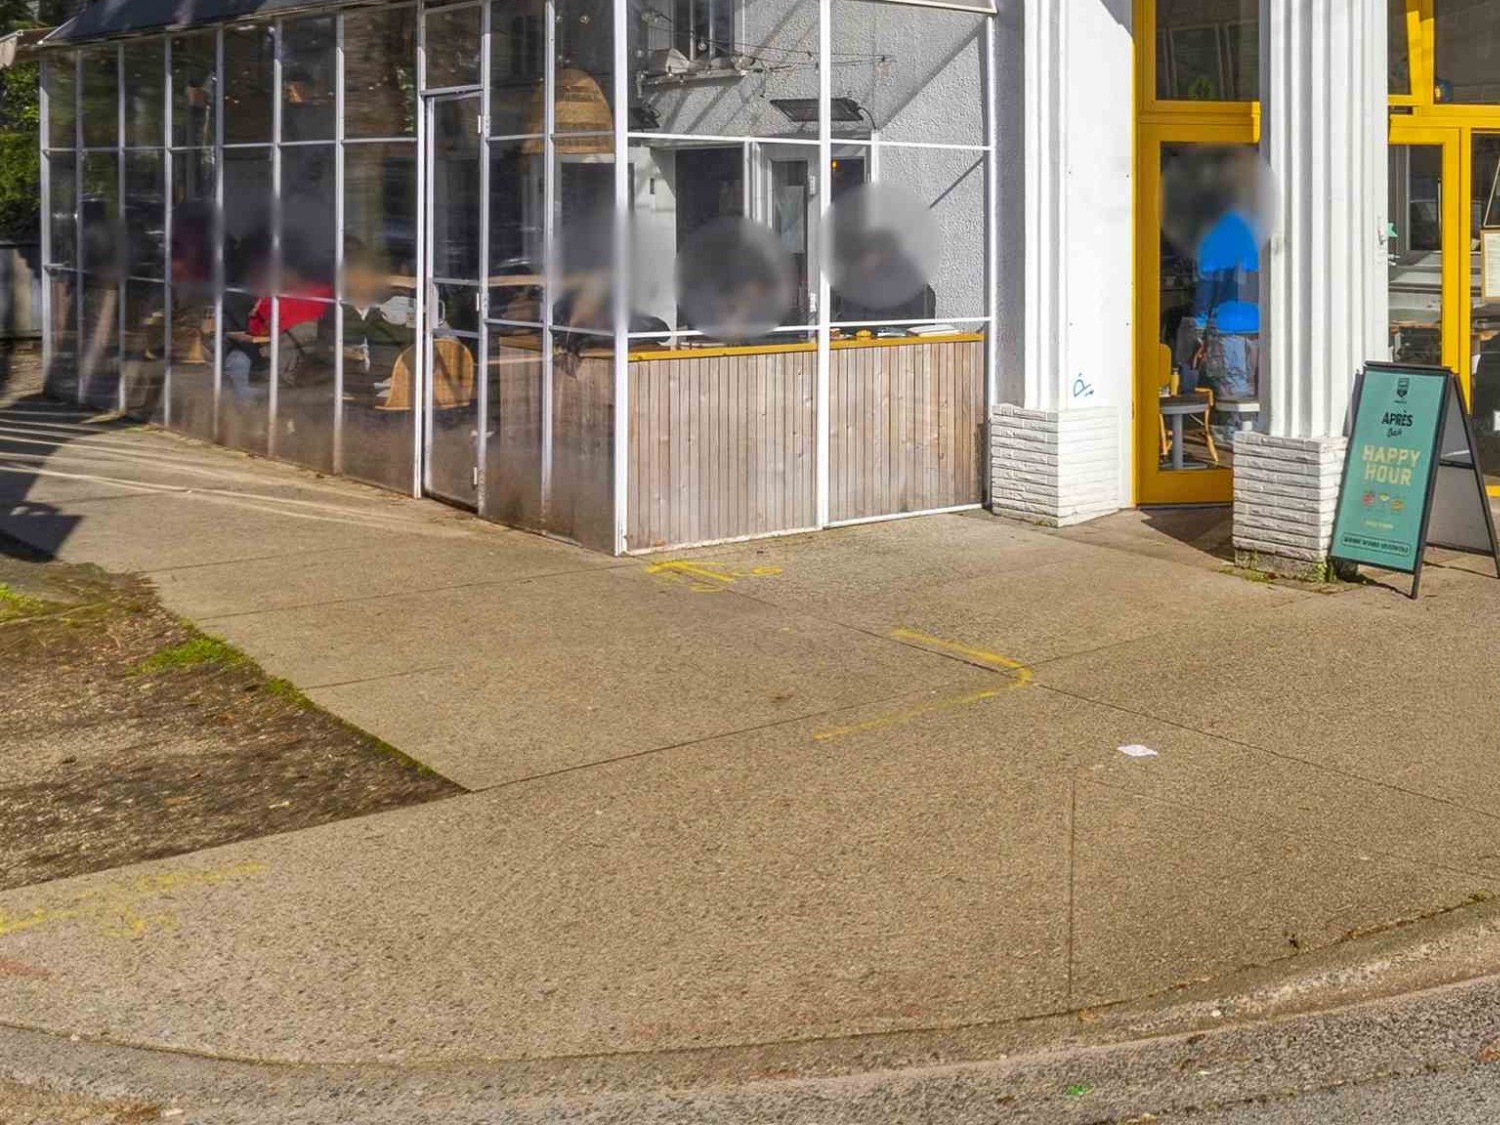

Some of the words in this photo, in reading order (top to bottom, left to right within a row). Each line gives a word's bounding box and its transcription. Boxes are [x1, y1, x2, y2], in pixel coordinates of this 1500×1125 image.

[1381, 409, 1413, 427] APRÈS
[1363, 444, 1420, 468] HAPPY
[1365, 461, 1412, 487] HOUR
